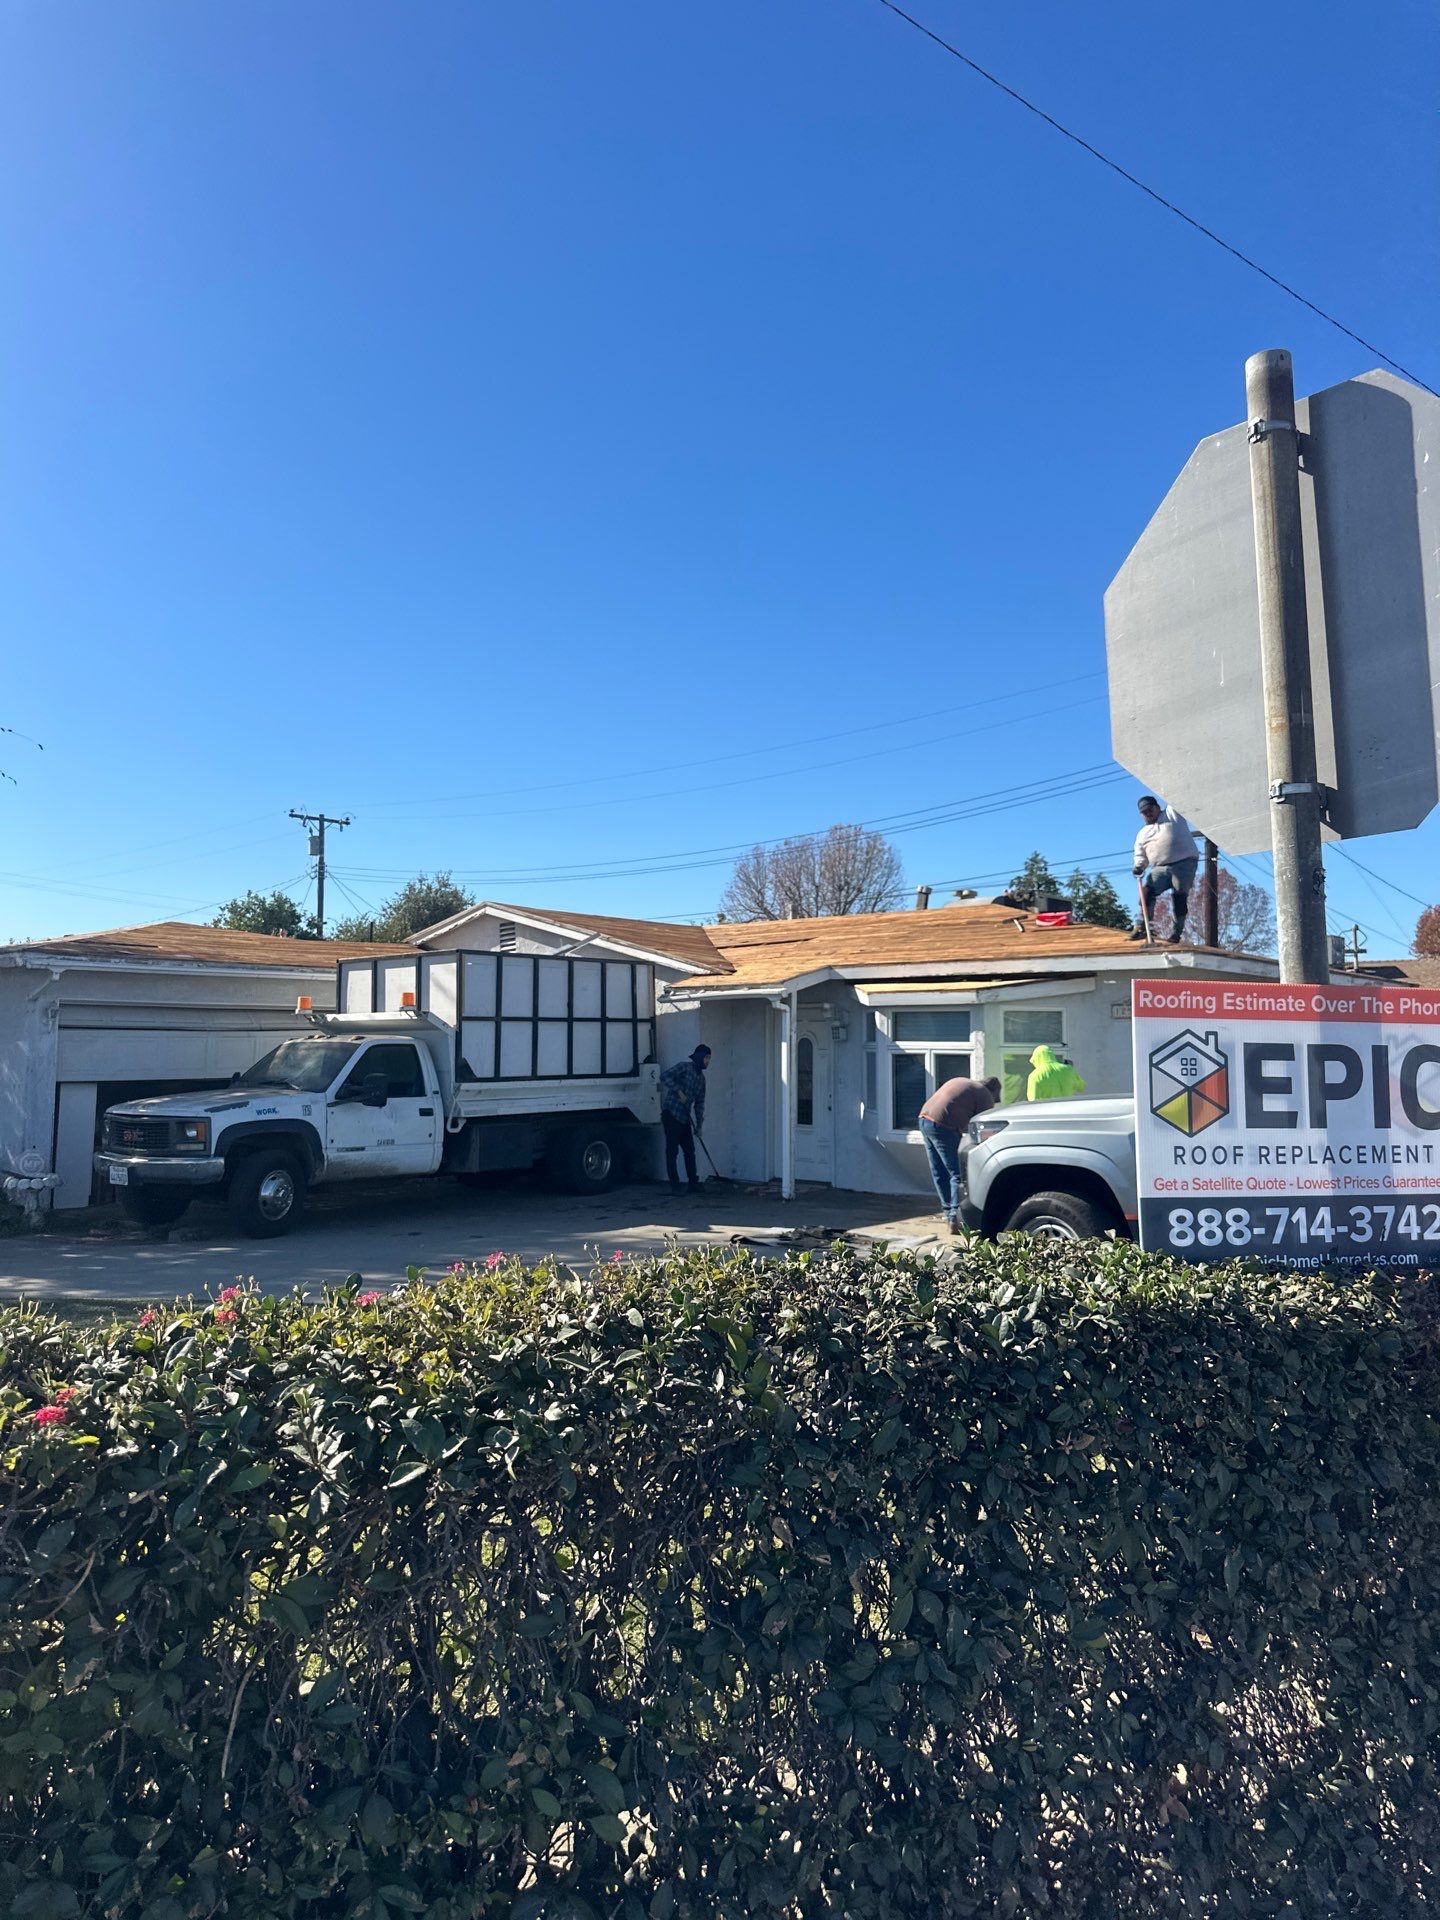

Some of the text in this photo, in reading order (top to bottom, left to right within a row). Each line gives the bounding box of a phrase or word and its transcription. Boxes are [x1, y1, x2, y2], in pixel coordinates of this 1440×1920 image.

[1139, 990, 1217, 1013] Roofing
[1223, 992, 1306, 1013] Estimate
[1311, 995, 1355, 1014] Over
[1361, 996, 1394, 1015] The
[1243, 1042, 1440, 1131] EPIC
[1173, 1145, 1433, 1165] ROOF REPLACEMENT
[1153, 1177, 1179, 1191] Get
[1181, 1180, 1189, 1190] a
[1192, 1177, 1243, 1191] Satellite
[1246, 1178, 1287, 1191] Quote
[1297, 1177, 1341, 1190] Lowest
[1344, 1176, 1380, 1189] Prices
[1168, 1204, 1440, 1247] 888-714-3742
